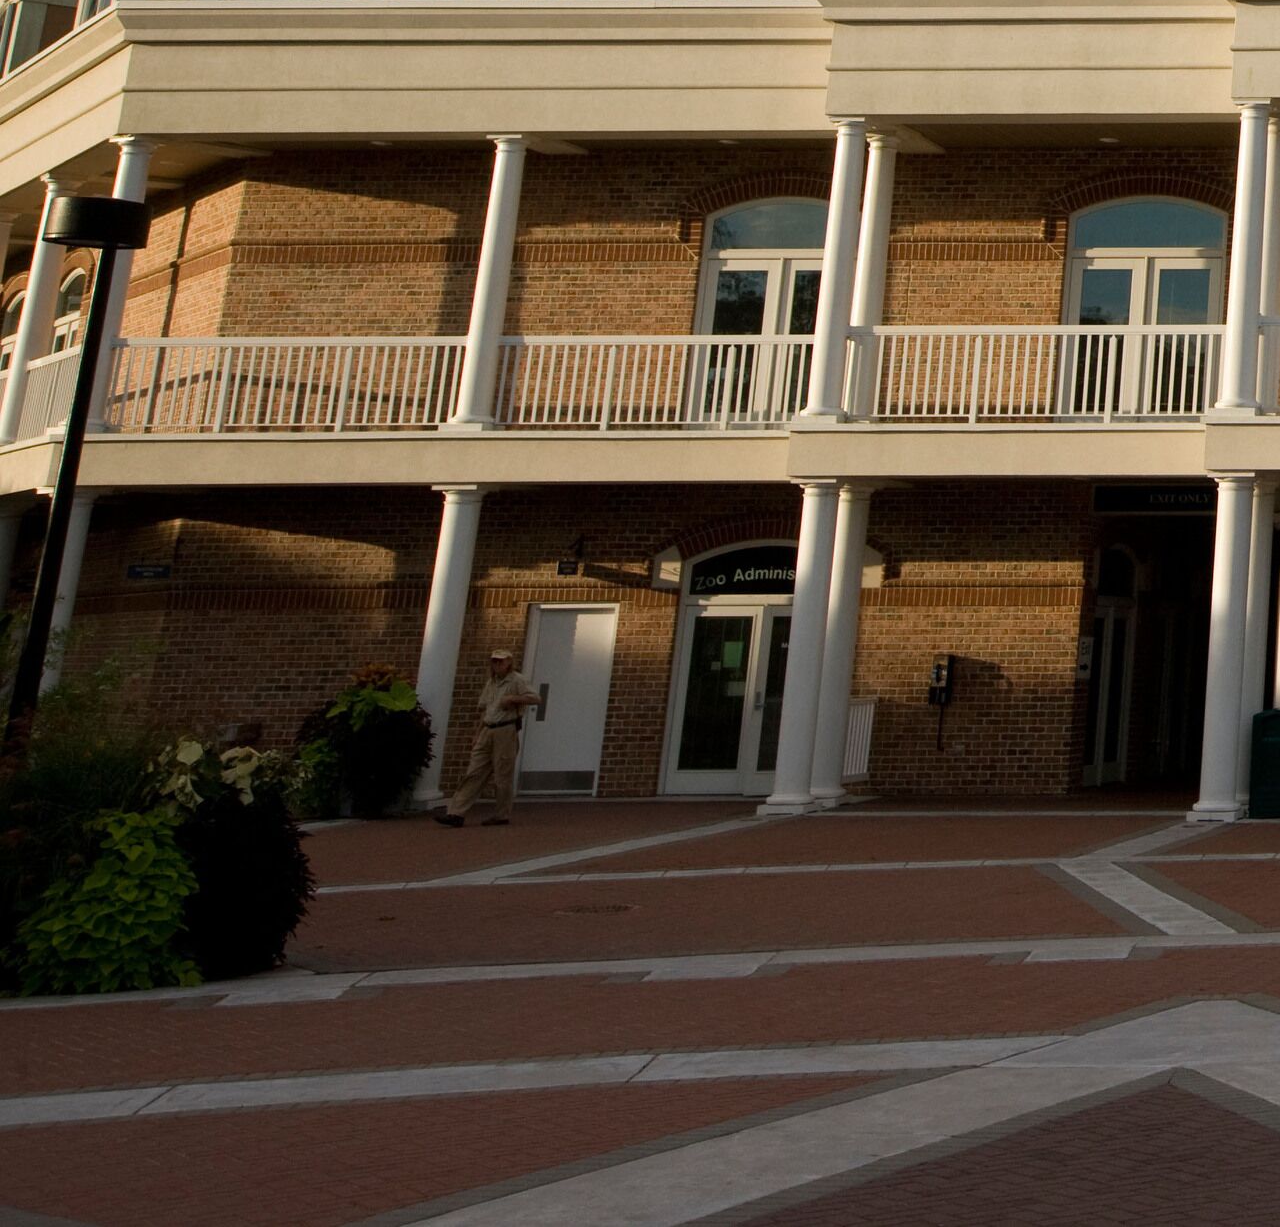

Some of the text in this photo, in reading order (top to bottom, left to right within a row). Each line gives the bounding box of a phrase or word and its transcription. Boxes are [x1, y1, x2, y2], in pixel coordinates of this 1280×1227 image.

[1149, 494, 1210, 503] EXIT ONLY
[694, 574, 726, 591] Zoo
